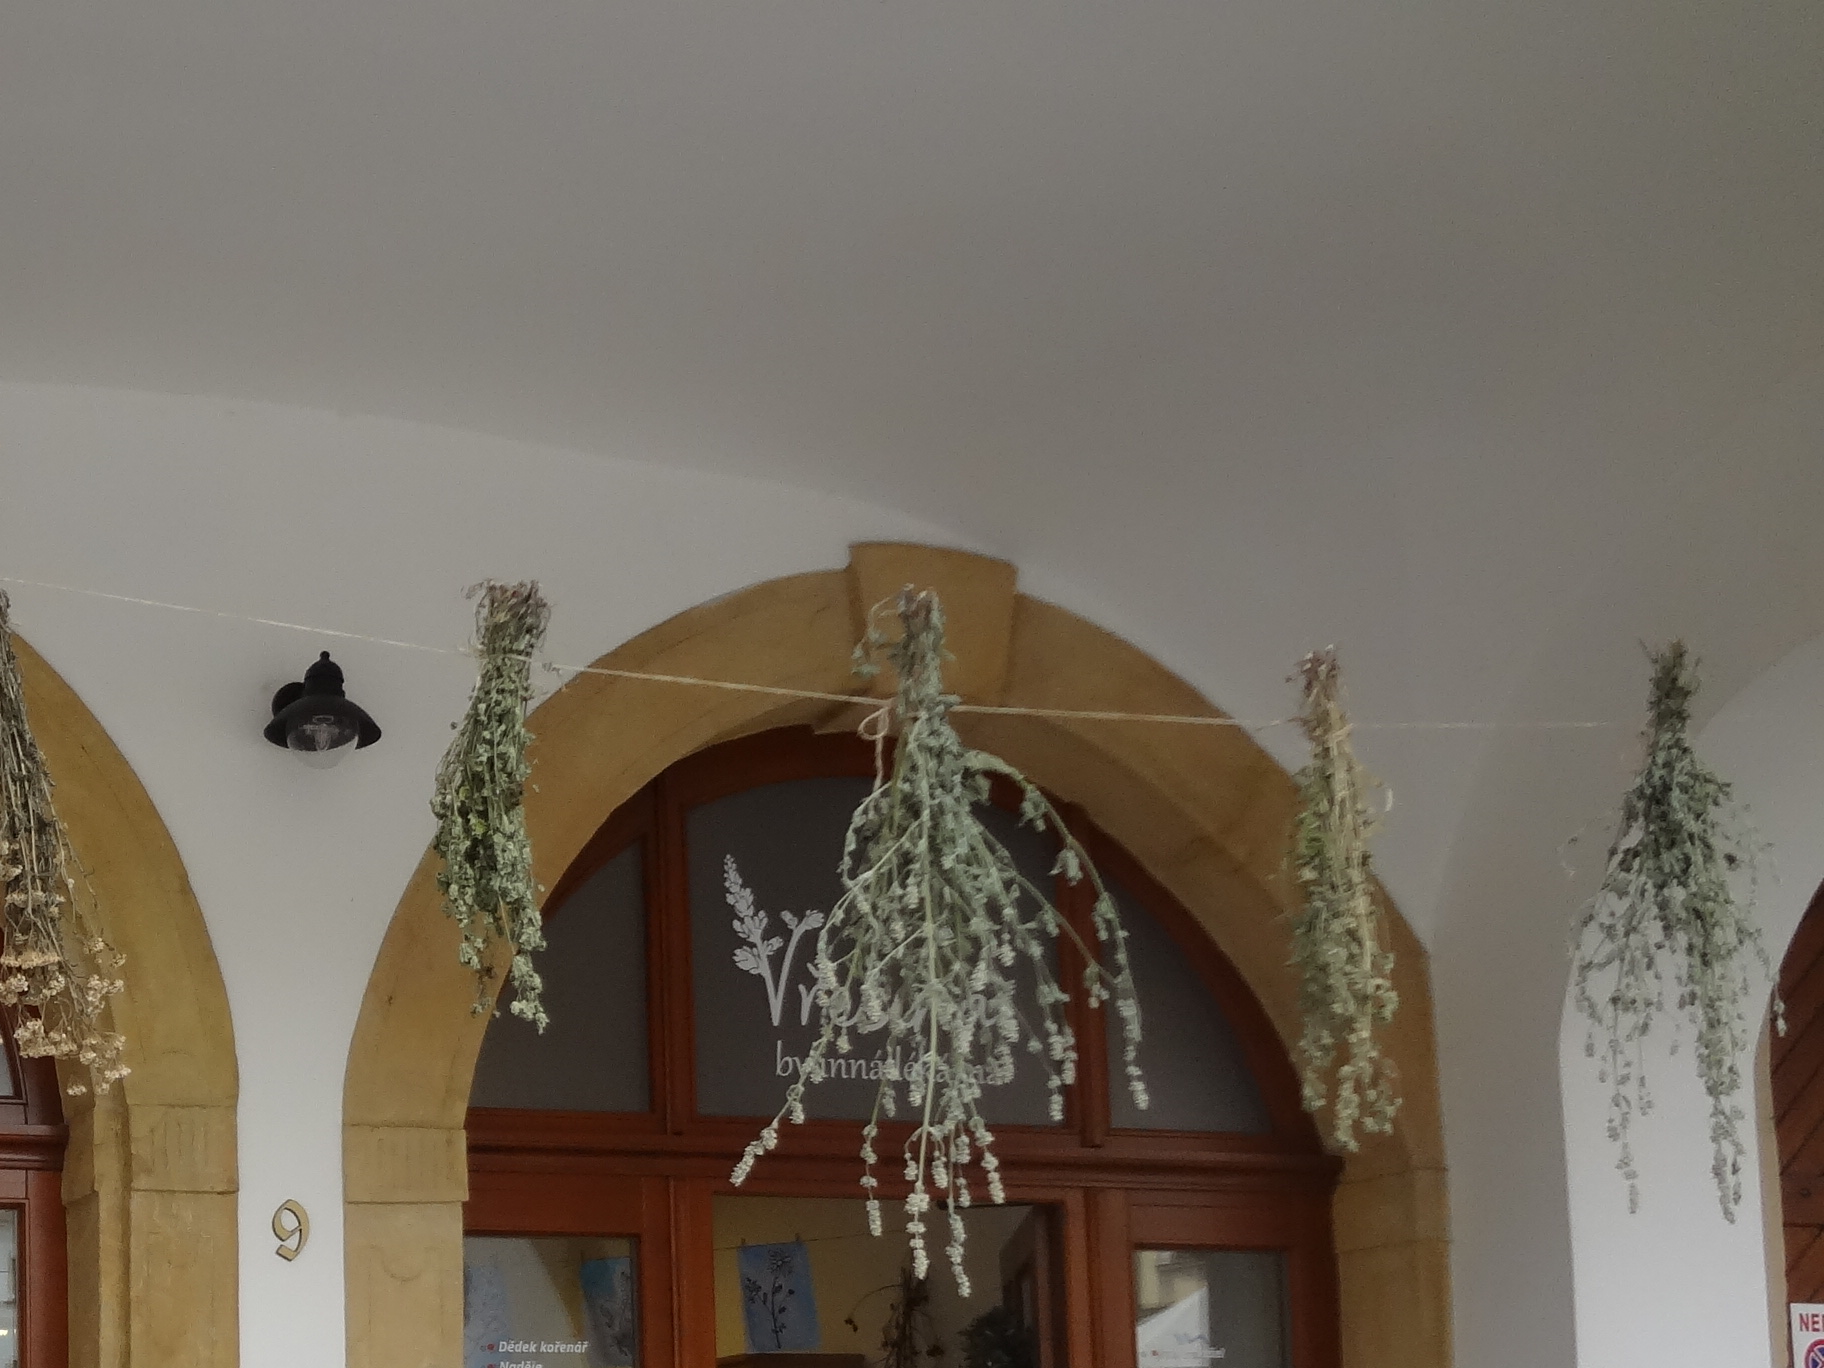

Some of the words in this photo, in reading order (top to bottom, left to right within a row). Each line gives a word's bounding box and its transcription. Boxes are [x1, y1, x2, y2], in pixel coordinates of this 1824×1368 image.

[272, 1198, 309, 1262] 9
[498, 1340, 537, 1353] Dědek
[539, 1340, 589, 1353] kořenář
